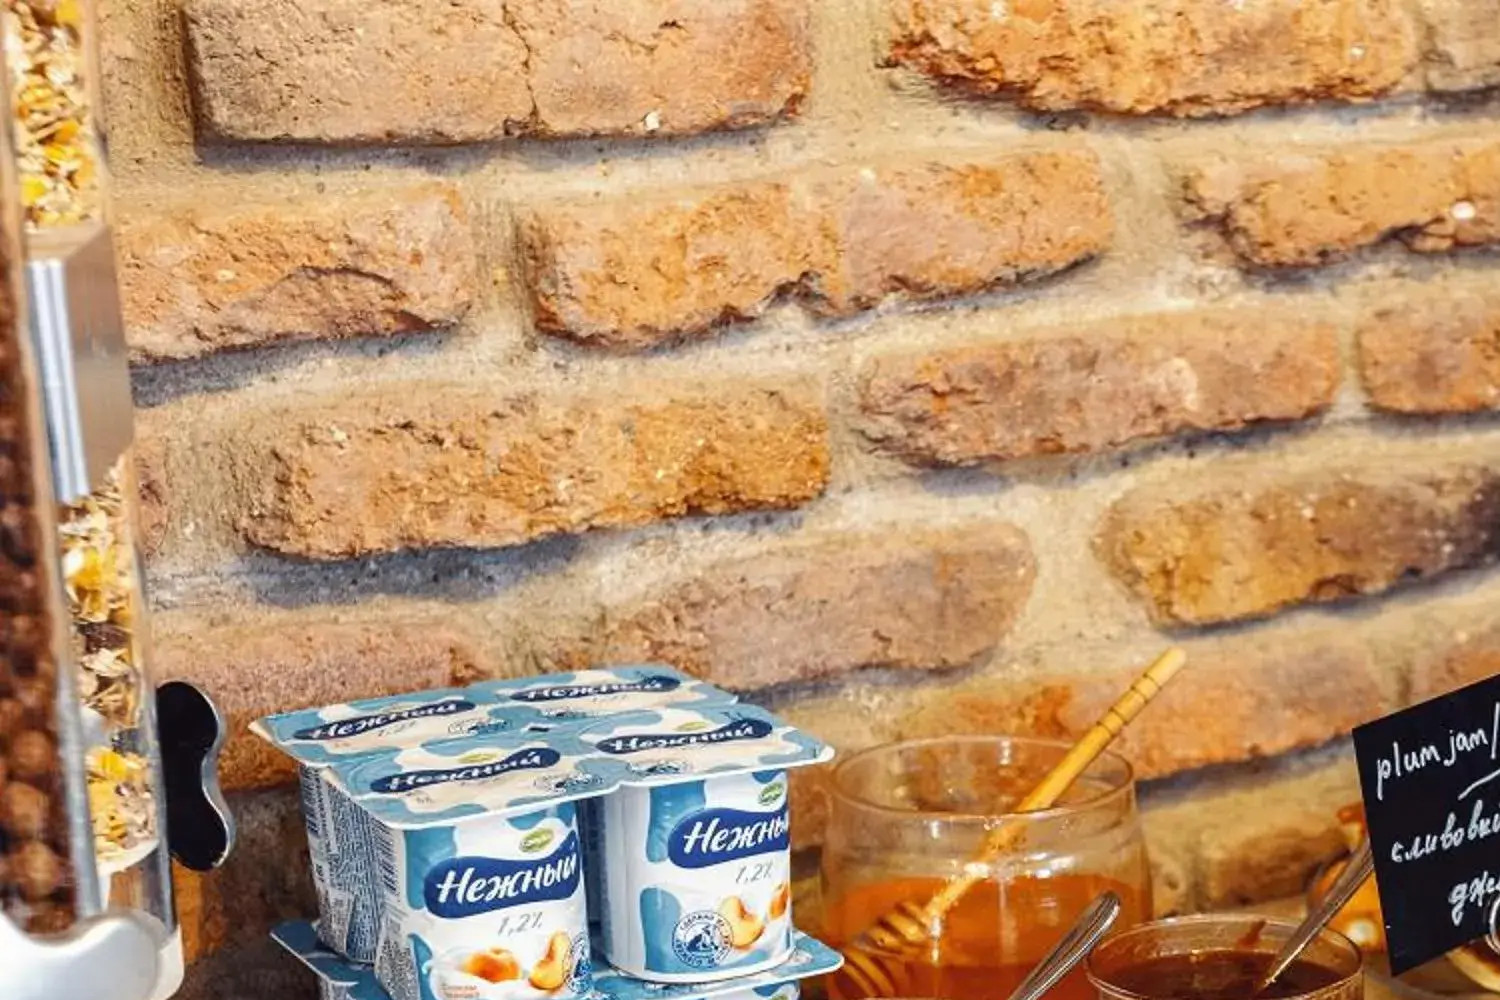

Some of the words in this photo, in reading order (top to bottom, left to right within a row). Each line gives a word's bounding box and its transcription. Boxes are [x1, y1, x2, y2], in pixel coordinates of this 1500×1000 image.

[1377, 741, 1441, 800] plum
[684, 809, 789, 854] Нежны
[436, 841, 578, 904] Нежный
